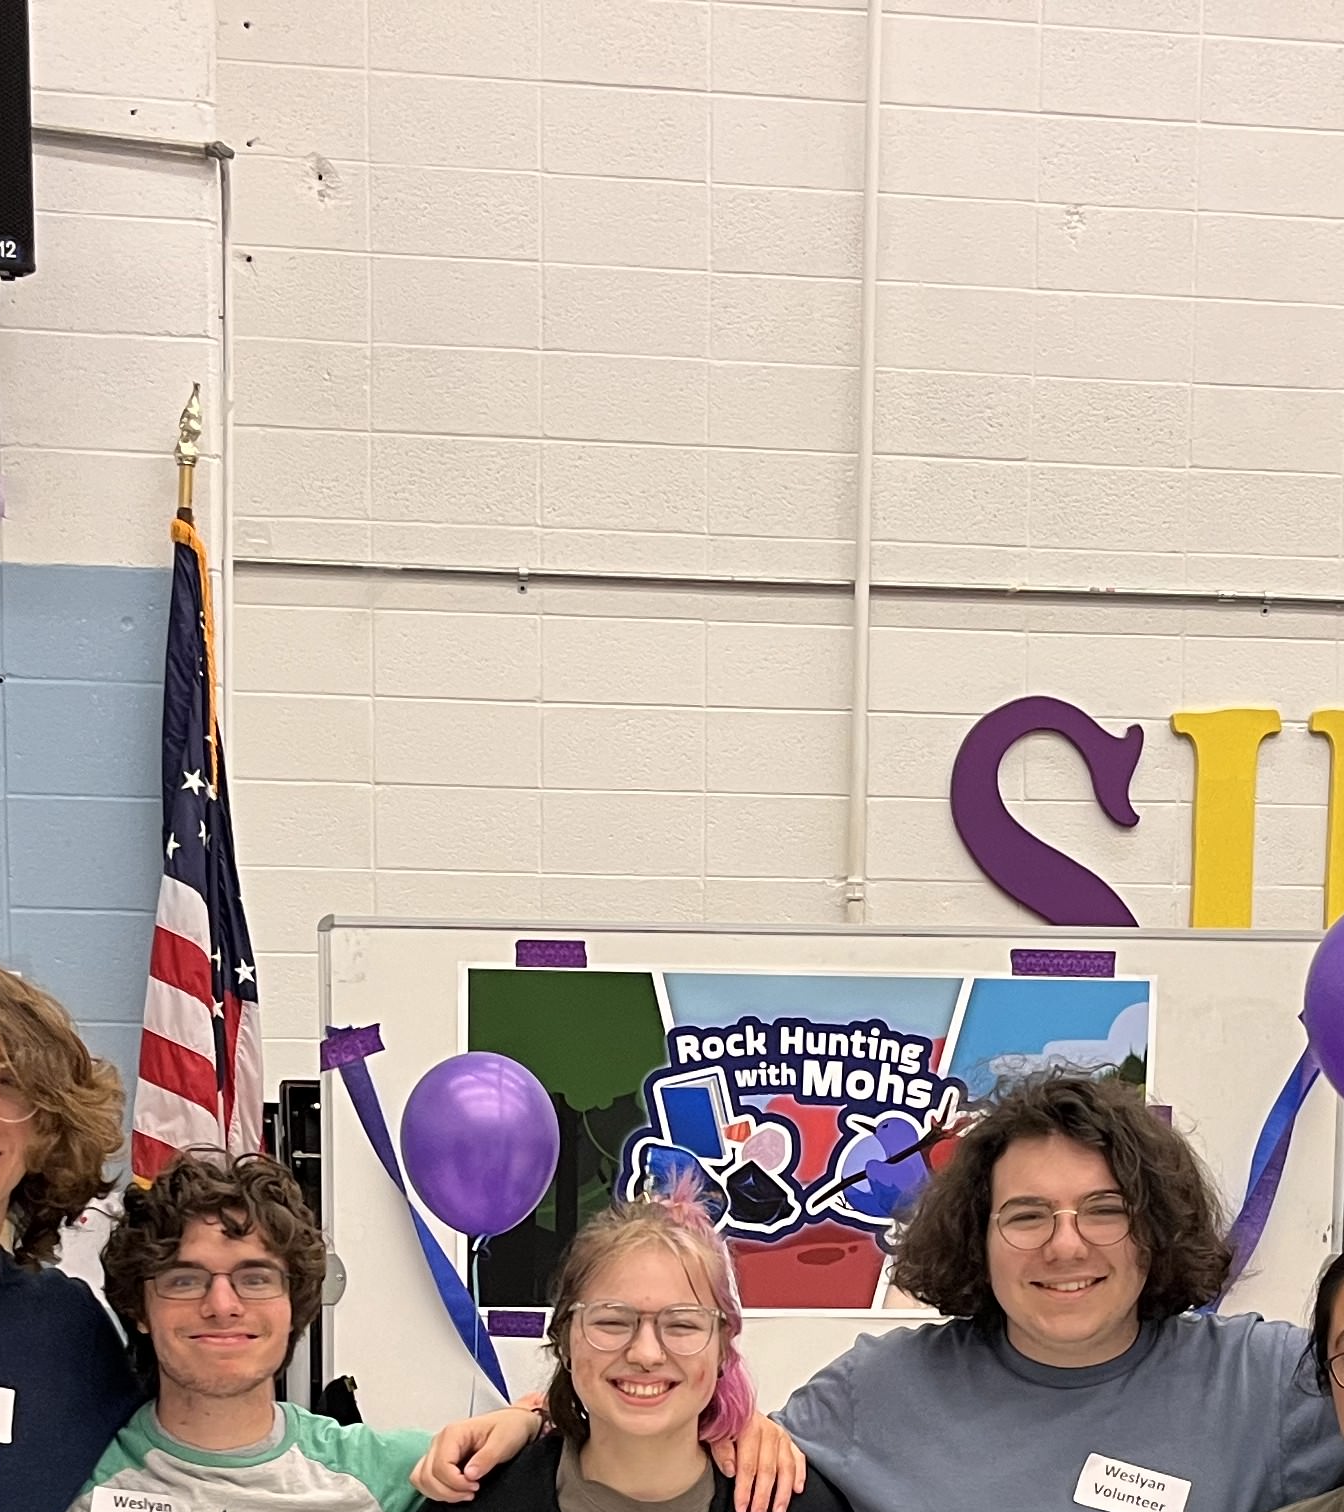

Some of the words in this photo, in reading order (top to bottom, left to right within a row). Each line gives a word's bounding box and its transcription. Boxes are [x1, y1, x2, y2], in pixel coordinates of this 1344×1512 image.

[675, 1024, 767, 1065] Rock
[780, 1026, 925, 1075] Hunting
[734, 1061, 797, 1088] with
[802, 1059, 933, 1109] Mohs
[1105, 1464, 1166, 1492] Weslyan
[113, 1495, 173, 1512] Weslyan
[1094, 1482, 1167, 1512] Volunteer
